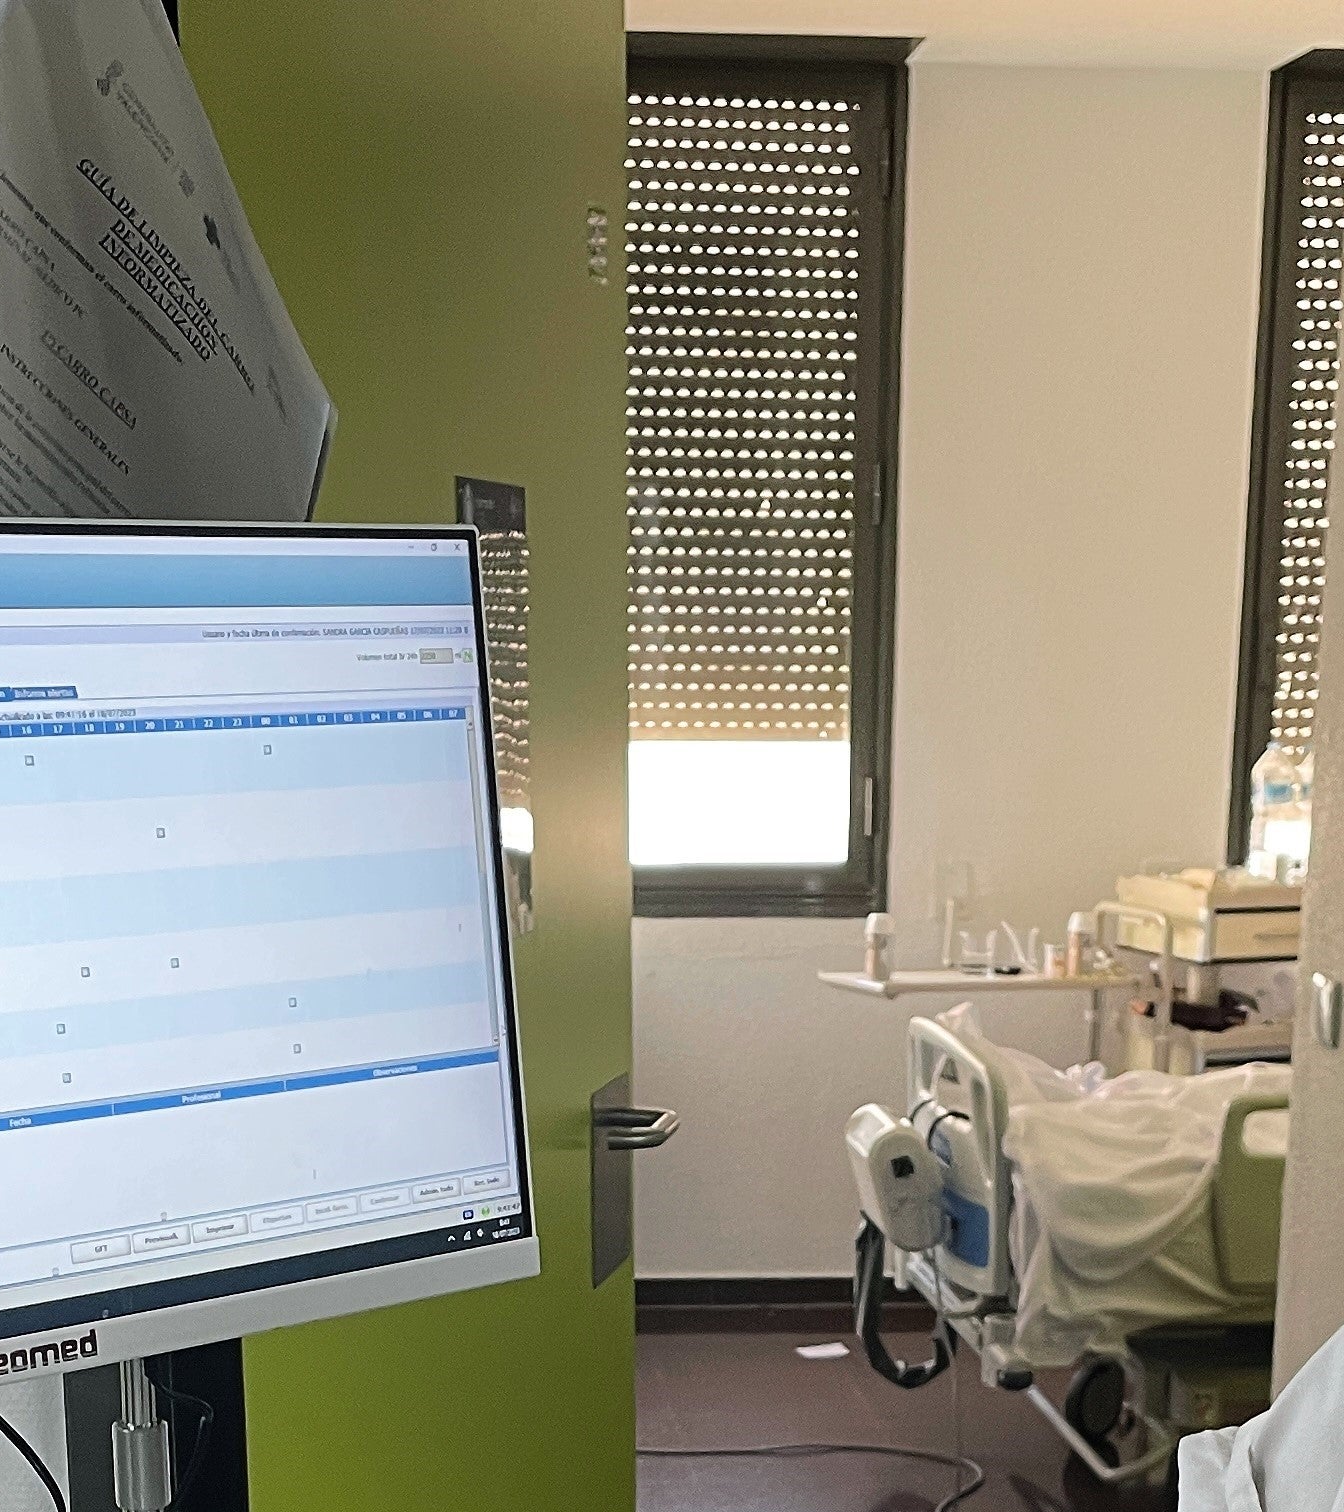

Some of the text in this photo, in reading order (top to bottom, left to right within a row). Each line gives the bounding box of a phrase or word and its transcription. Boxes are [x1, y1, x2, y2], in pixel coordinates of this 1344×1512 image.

[113, 196, 142, 225] DE
[109, 218, 138, 248] DE
[98, 233, 212, 362] INFORMATIZADO
